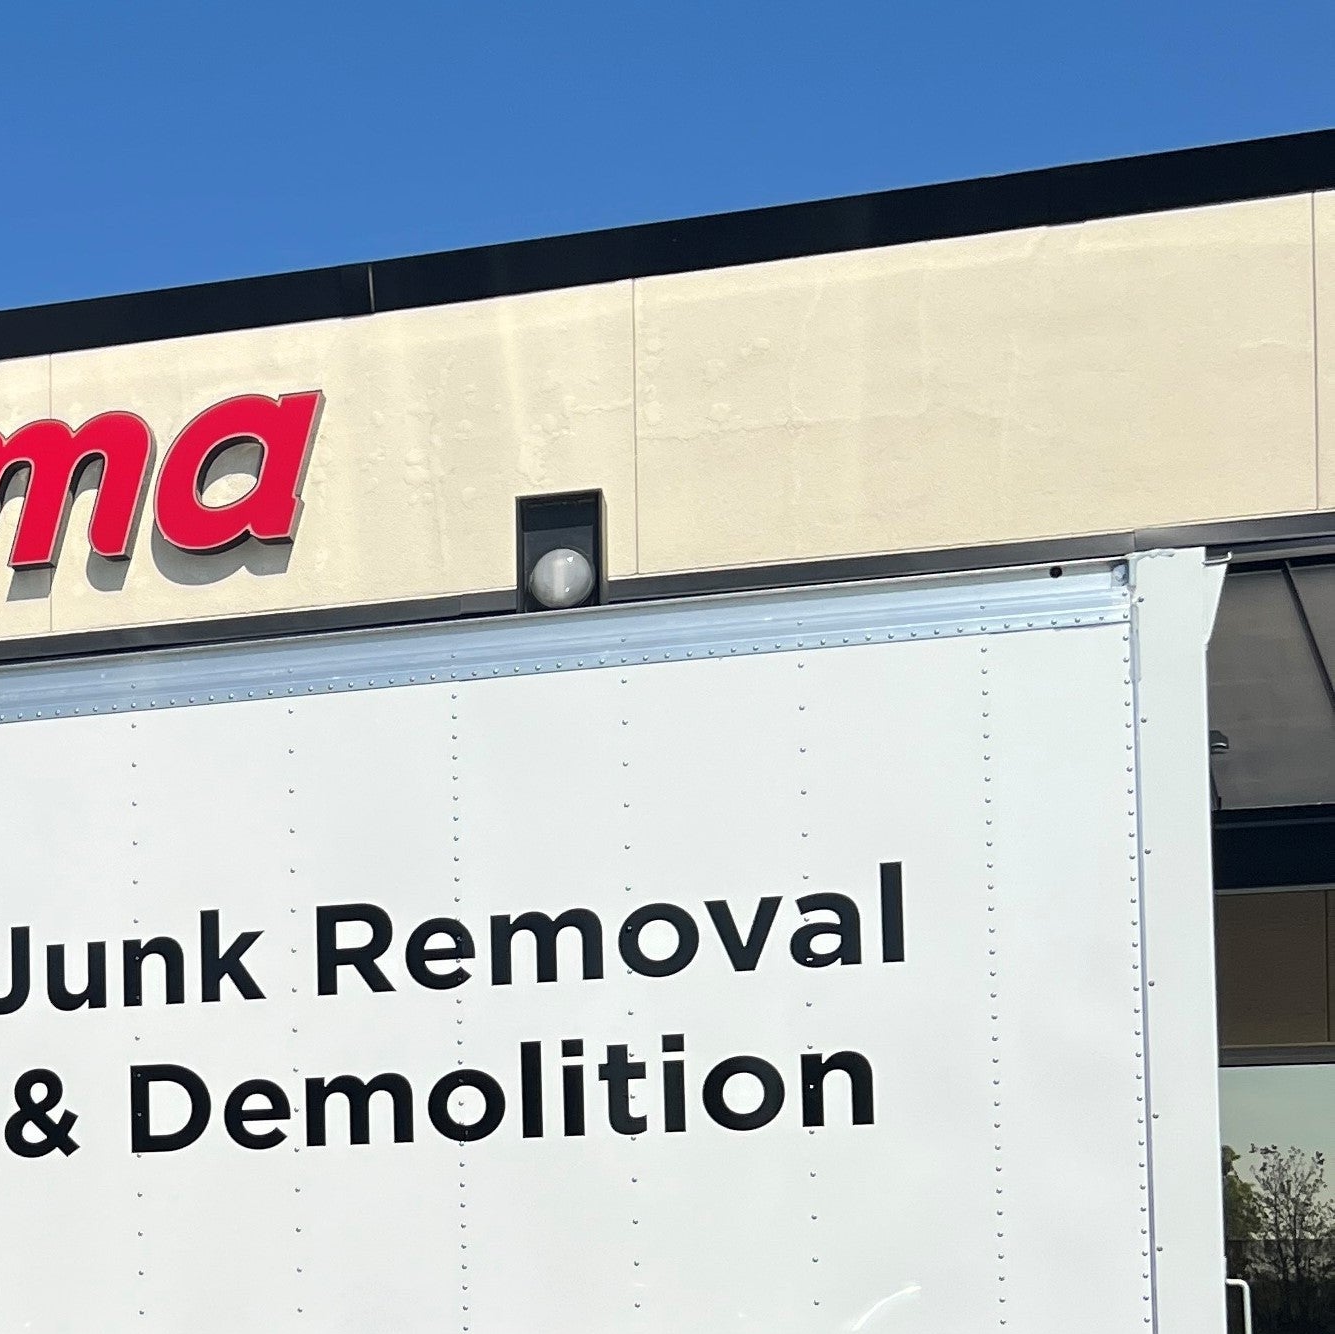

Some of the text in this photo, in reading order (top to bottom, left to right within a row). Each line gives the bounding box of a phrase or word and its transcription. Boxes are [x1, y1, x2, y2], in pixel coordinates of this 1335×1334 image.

[316, 861, 905, 998] Removal
[4, 1034, 875, 1159] & Demolition
